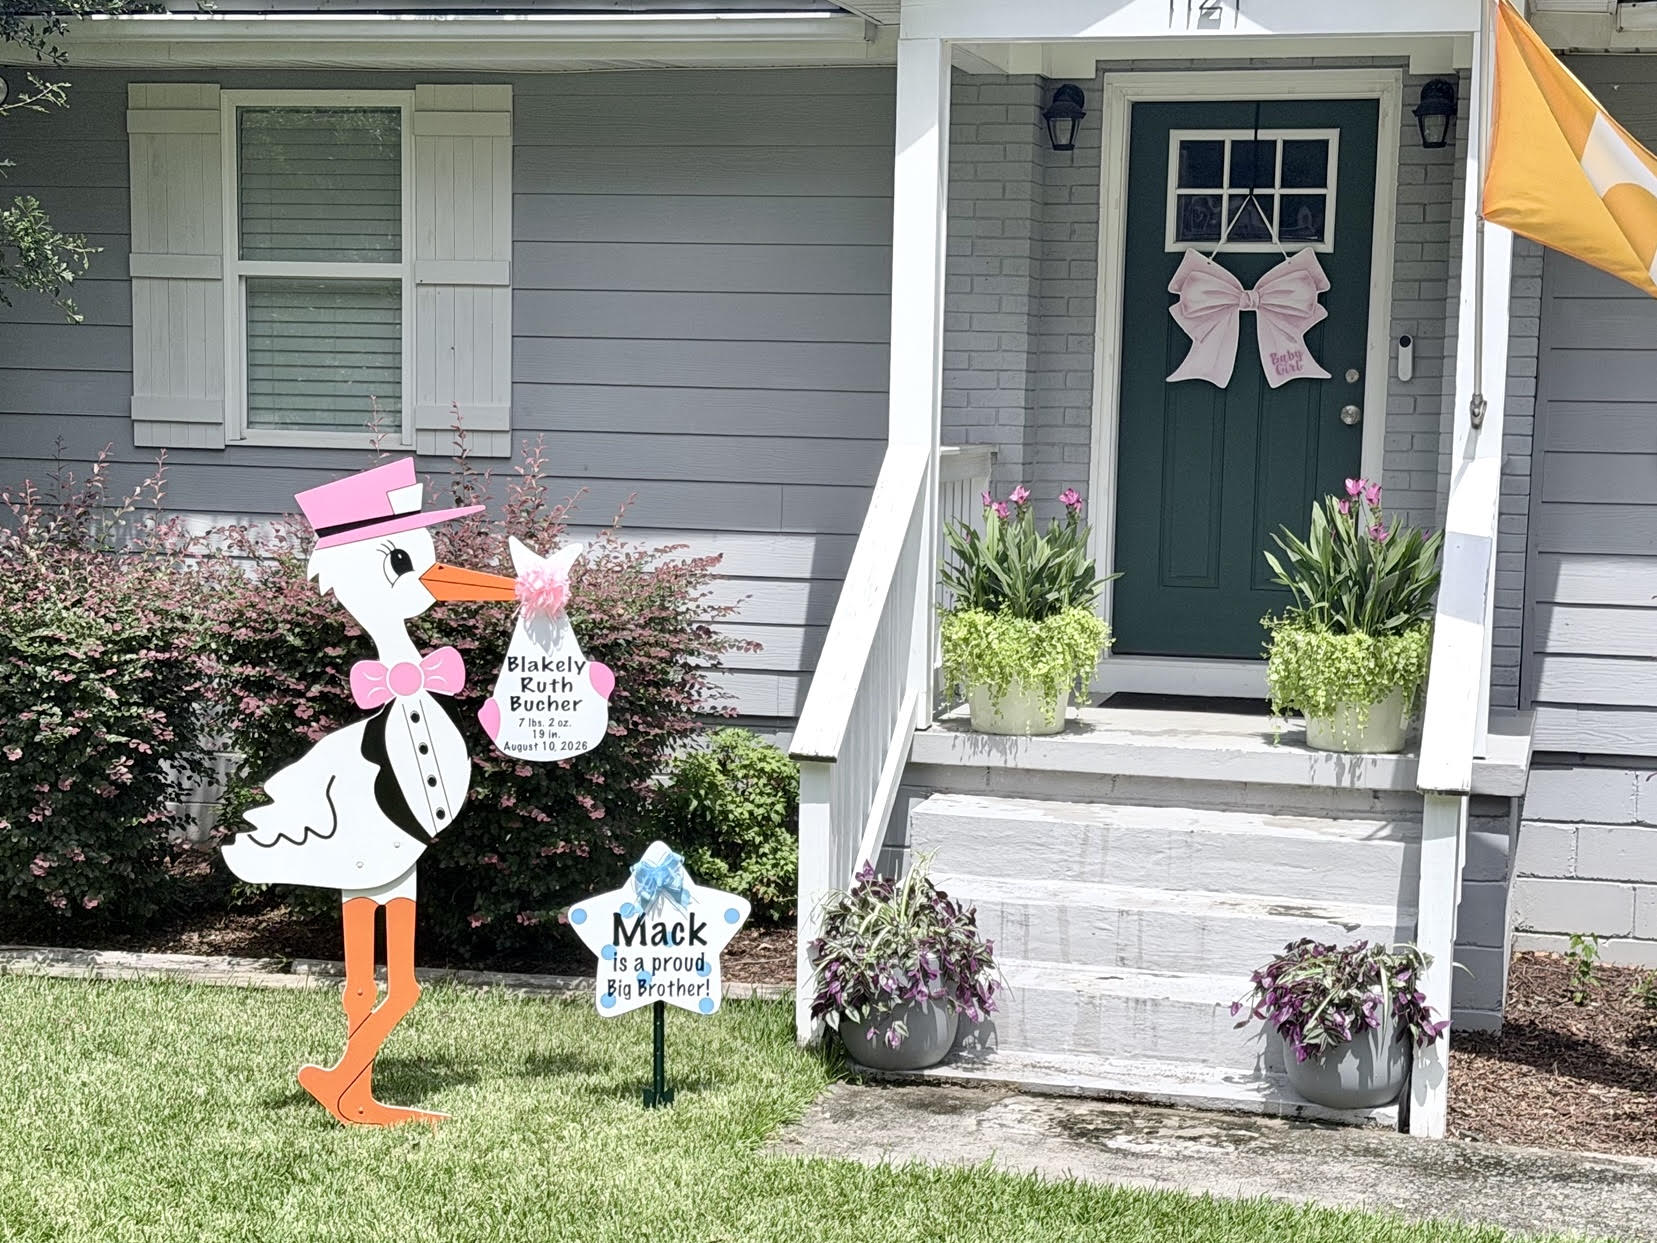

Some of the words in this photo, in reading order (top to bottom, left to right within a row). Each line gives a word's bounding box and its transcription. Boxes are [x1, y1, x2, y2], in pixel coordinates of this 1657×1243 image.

[1270, 350, 1303, 366] Baby
[1275, 360, 1303, 376] Girl
[508, 656, 586, 675] Blakely
[521, 676, 573, 693] Ruth
[510, 695, 583, 712] Bucher
[519, 718, 525, 727] 7
[529, 718, 544, 728] lbs.
[548, 718, 555, 727] 2
[533, 729, 545, 739] 19
[548, 729, 561, 738] in.
[504, 741, 538, 752] August
[543, 741, 557, 752] 10,
[561, 741, 588, 751] 2026
[613, 912, 708, 947] Mack
[613, 952, 627, 972] is
[634, 957, 645, 972] a
[652, 952, 705, 976] proud
[608, 979, 631, 1000] Big
[638, 978, 710, 997] Brother!
